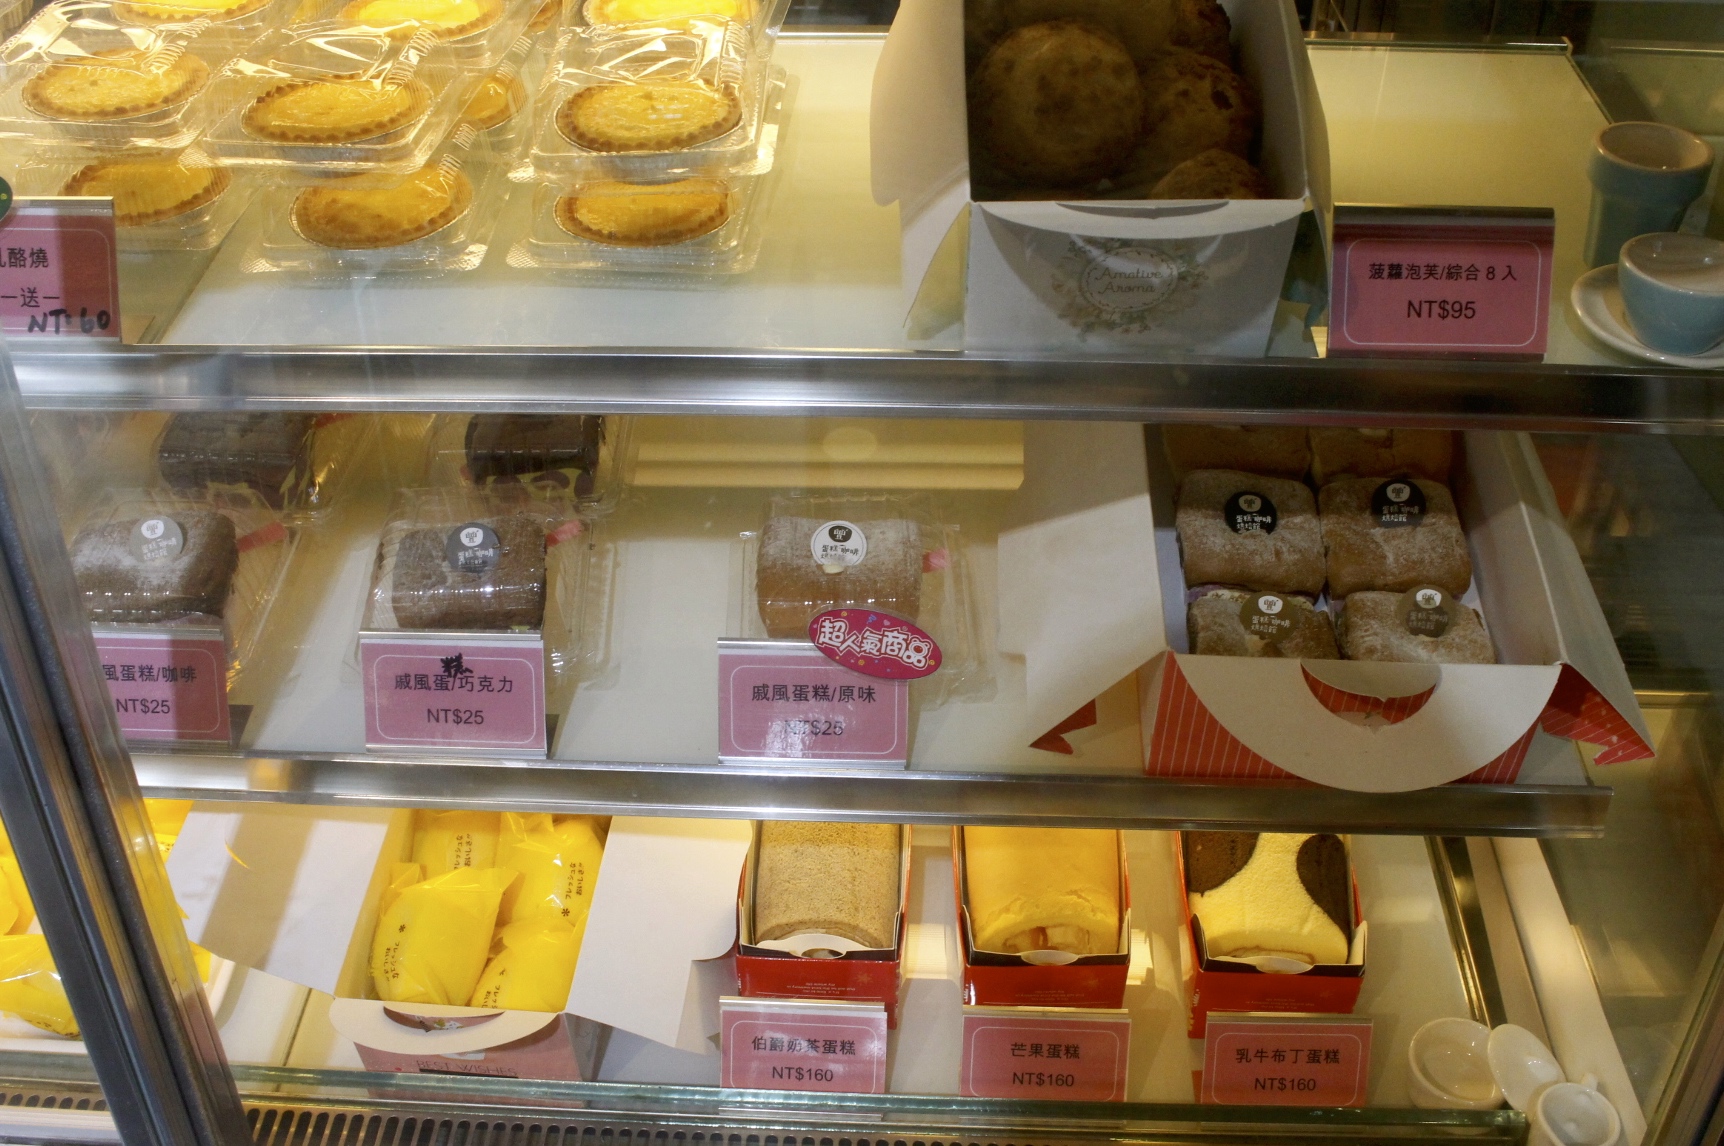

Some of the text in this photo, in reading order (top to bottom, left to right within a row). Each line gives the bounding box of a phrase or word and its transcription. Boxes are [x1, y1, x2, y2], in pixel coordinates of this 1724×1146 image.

[1095, 267, 1162, 281] Amative
[1098, 281, 1156, 295] Aroma
[1407, 300, 1477, 320] NT$95
[818, 617, 933, 670] 超人氣商品
[752, 683, 876, 703] 戚風蛋糕/原味
[116, 698, 171, 714] NT$25
[427, 708, 484, 725] NT$25
[784, 719, 844, 737] NT$25
[751, 1036, 856, 1056] 伯爵奶茶蛋糕
[1010, 1042, 1080, 1060] 芒果蛋糕
[1235, 1048, 1341, 1065] 乳牛布丁蛋糕
[416, 1060, 518, 1076] BEST WISHES
[772, 1066, 834, 1082] NT$160
[1013, 1072, 1075, 1087] NT$160
[1254, 1078, 1316, 1092] NT$160
